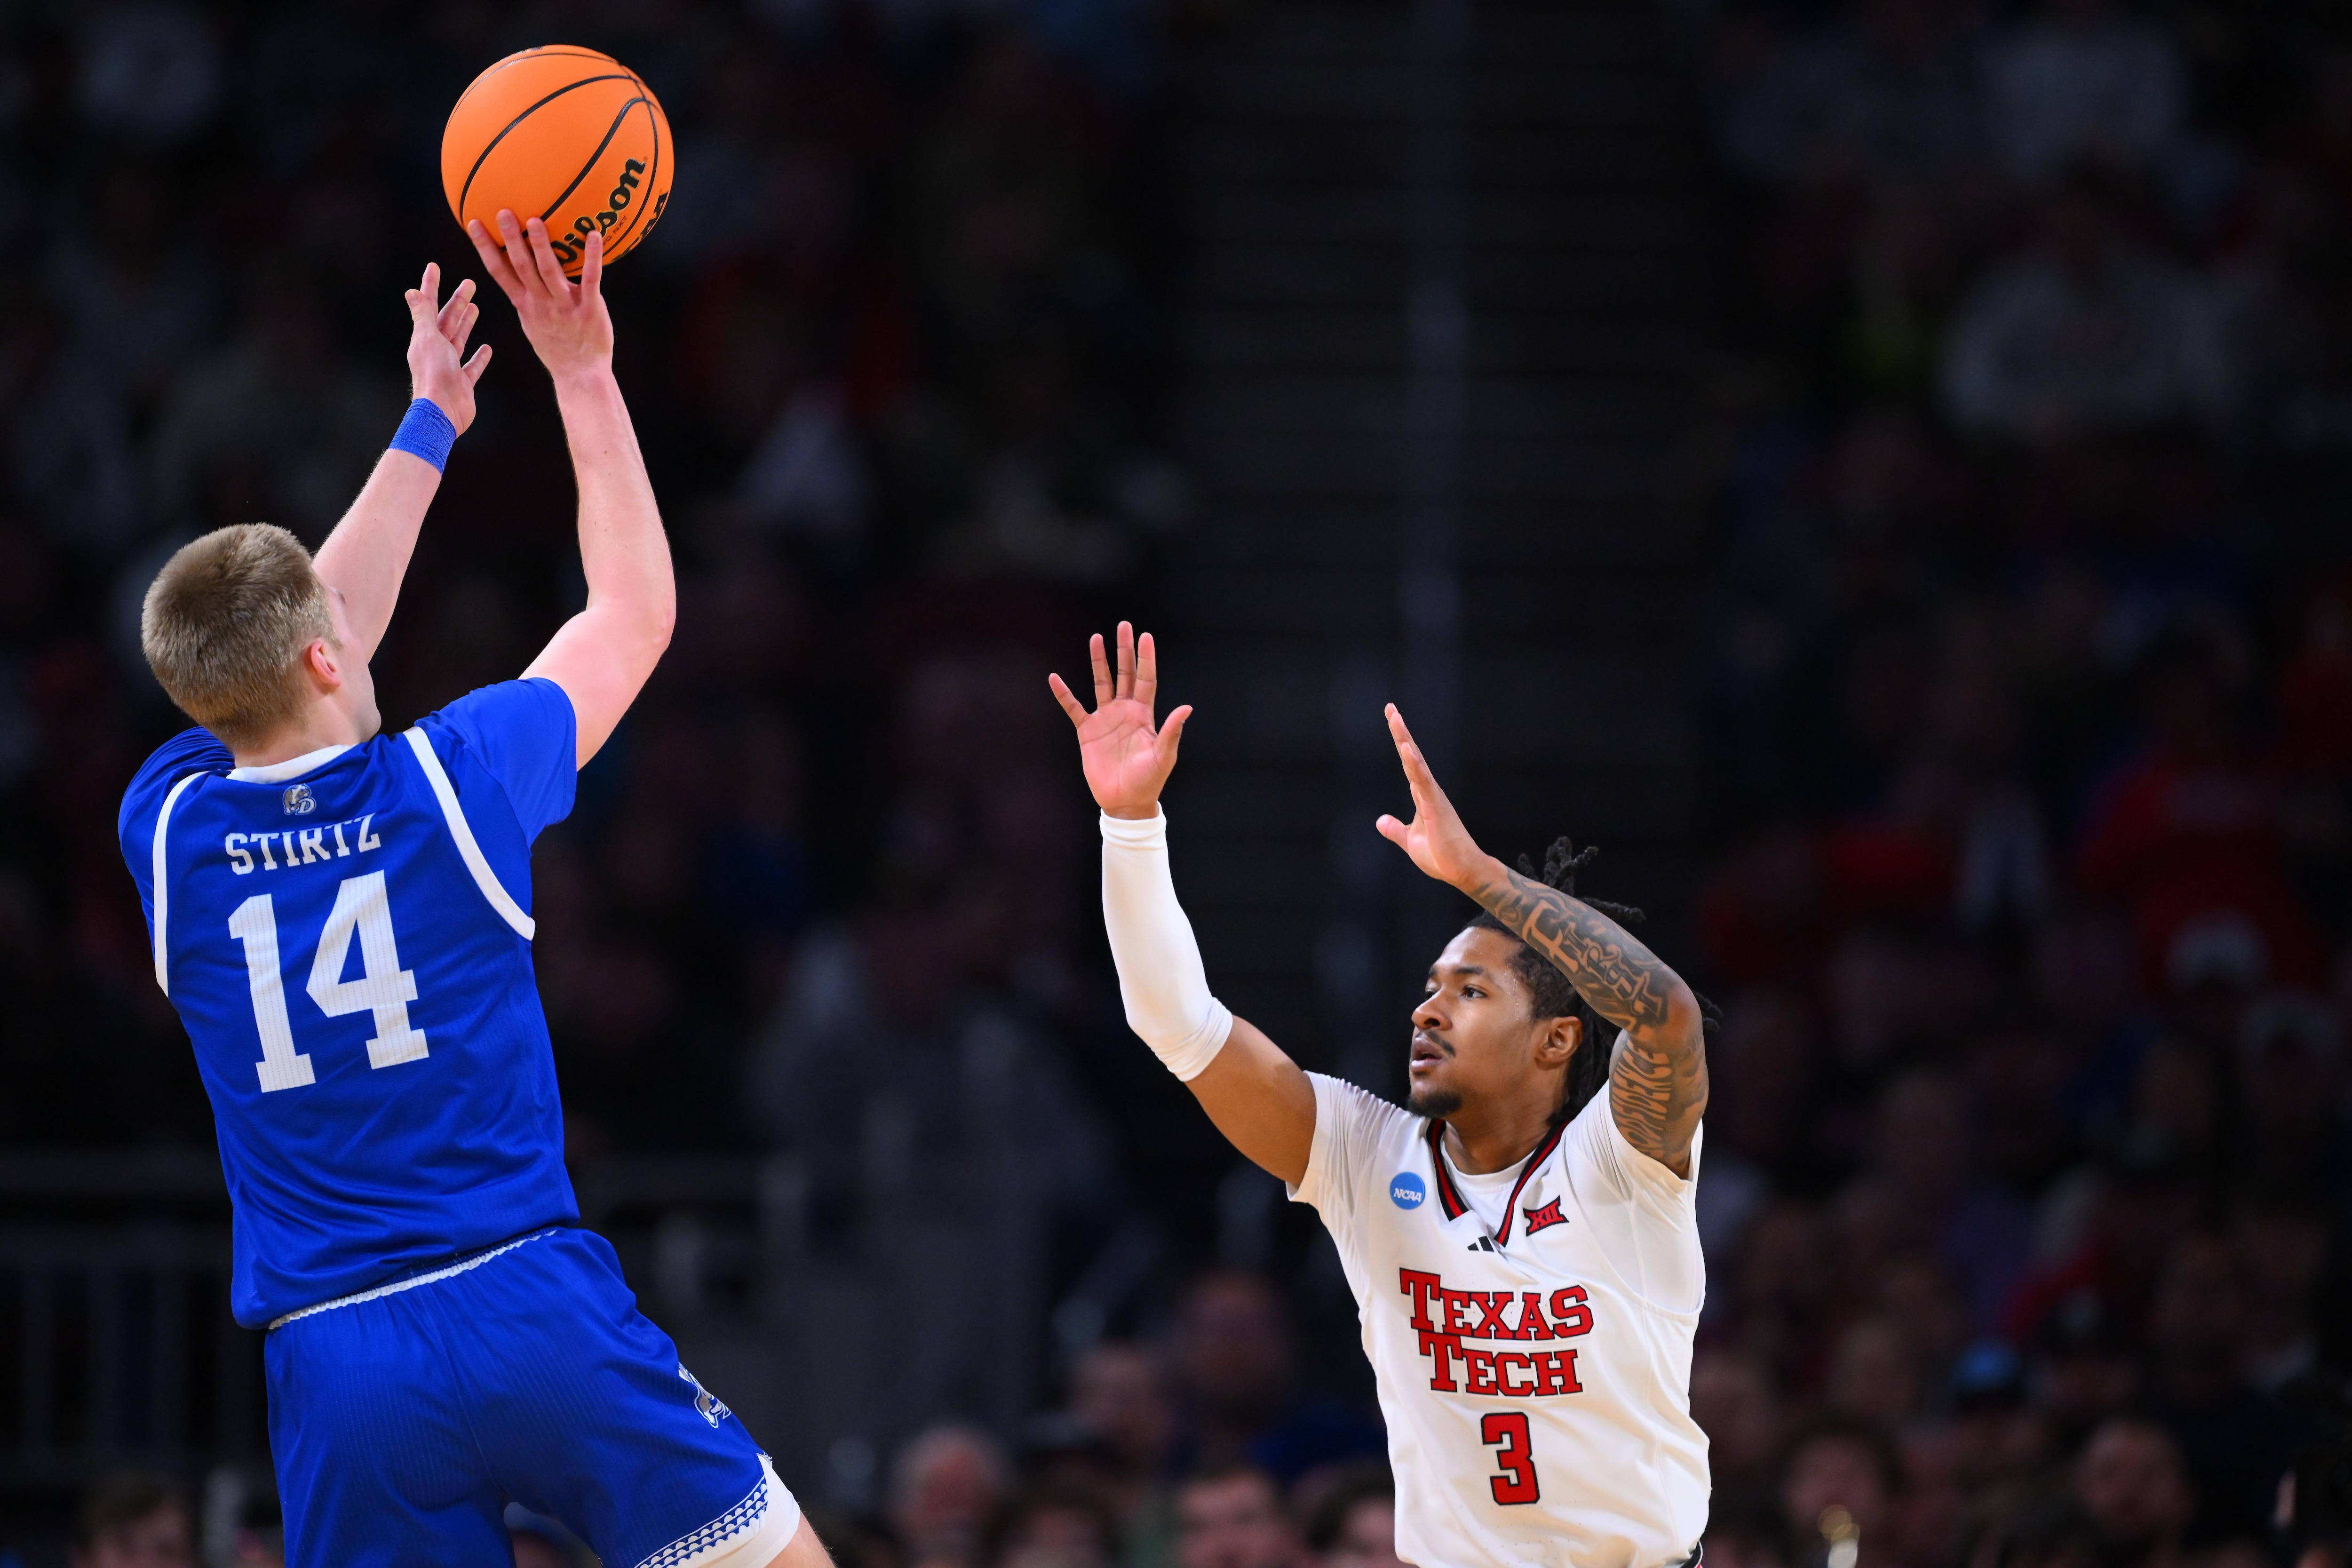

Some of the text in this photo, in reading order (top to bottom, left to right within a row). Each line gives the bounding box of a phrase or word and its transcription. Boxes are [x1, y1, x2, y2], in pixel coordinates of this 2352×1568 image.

[225, 813, 381, 876] STIRTZ
[228, 869, 430, 1093] 14
[1394, 1188, 1422, 1202] NCAA
[1525, 1198, 1566, 1234] XII
[1399, 1267, 1594, 1340] TEXAS
[1419, 1331, 1583, 1396] TECH
[1481, 1412, 1541, 1506] 3
